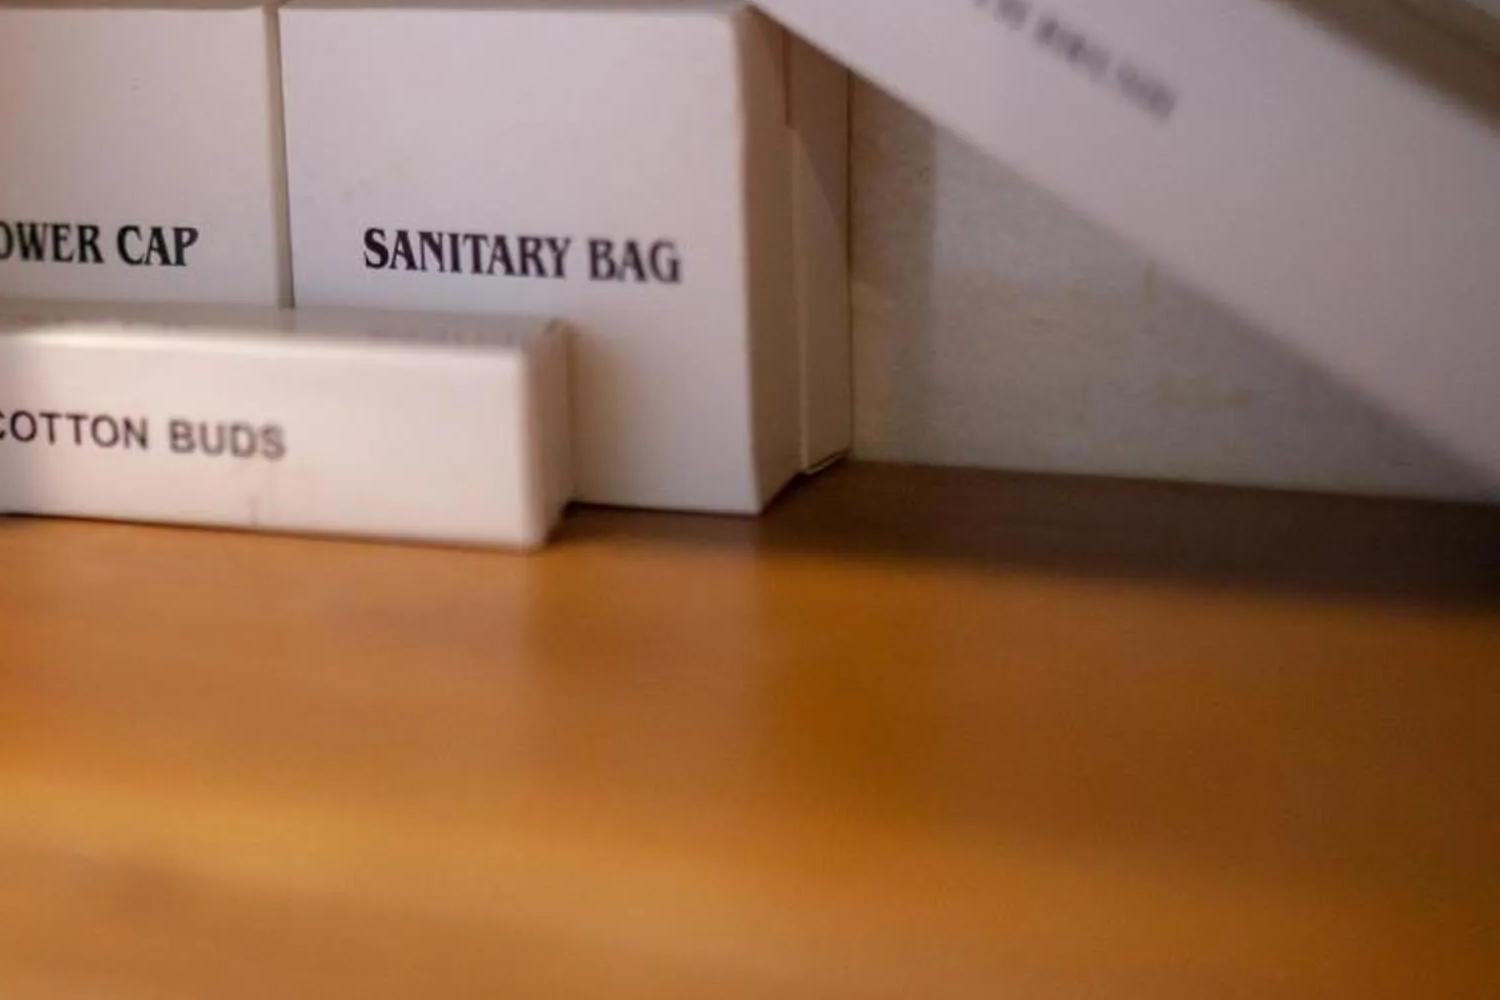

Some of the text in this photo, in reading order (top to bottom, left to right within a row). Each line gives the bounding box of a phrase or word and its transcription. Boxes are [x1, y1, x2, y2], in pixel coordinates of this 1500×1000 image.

[116, 224, 199, 267] CAP
[362, 227, 682, 284] SANITARY BAG
[167, 418, 287, 460] BUDS
